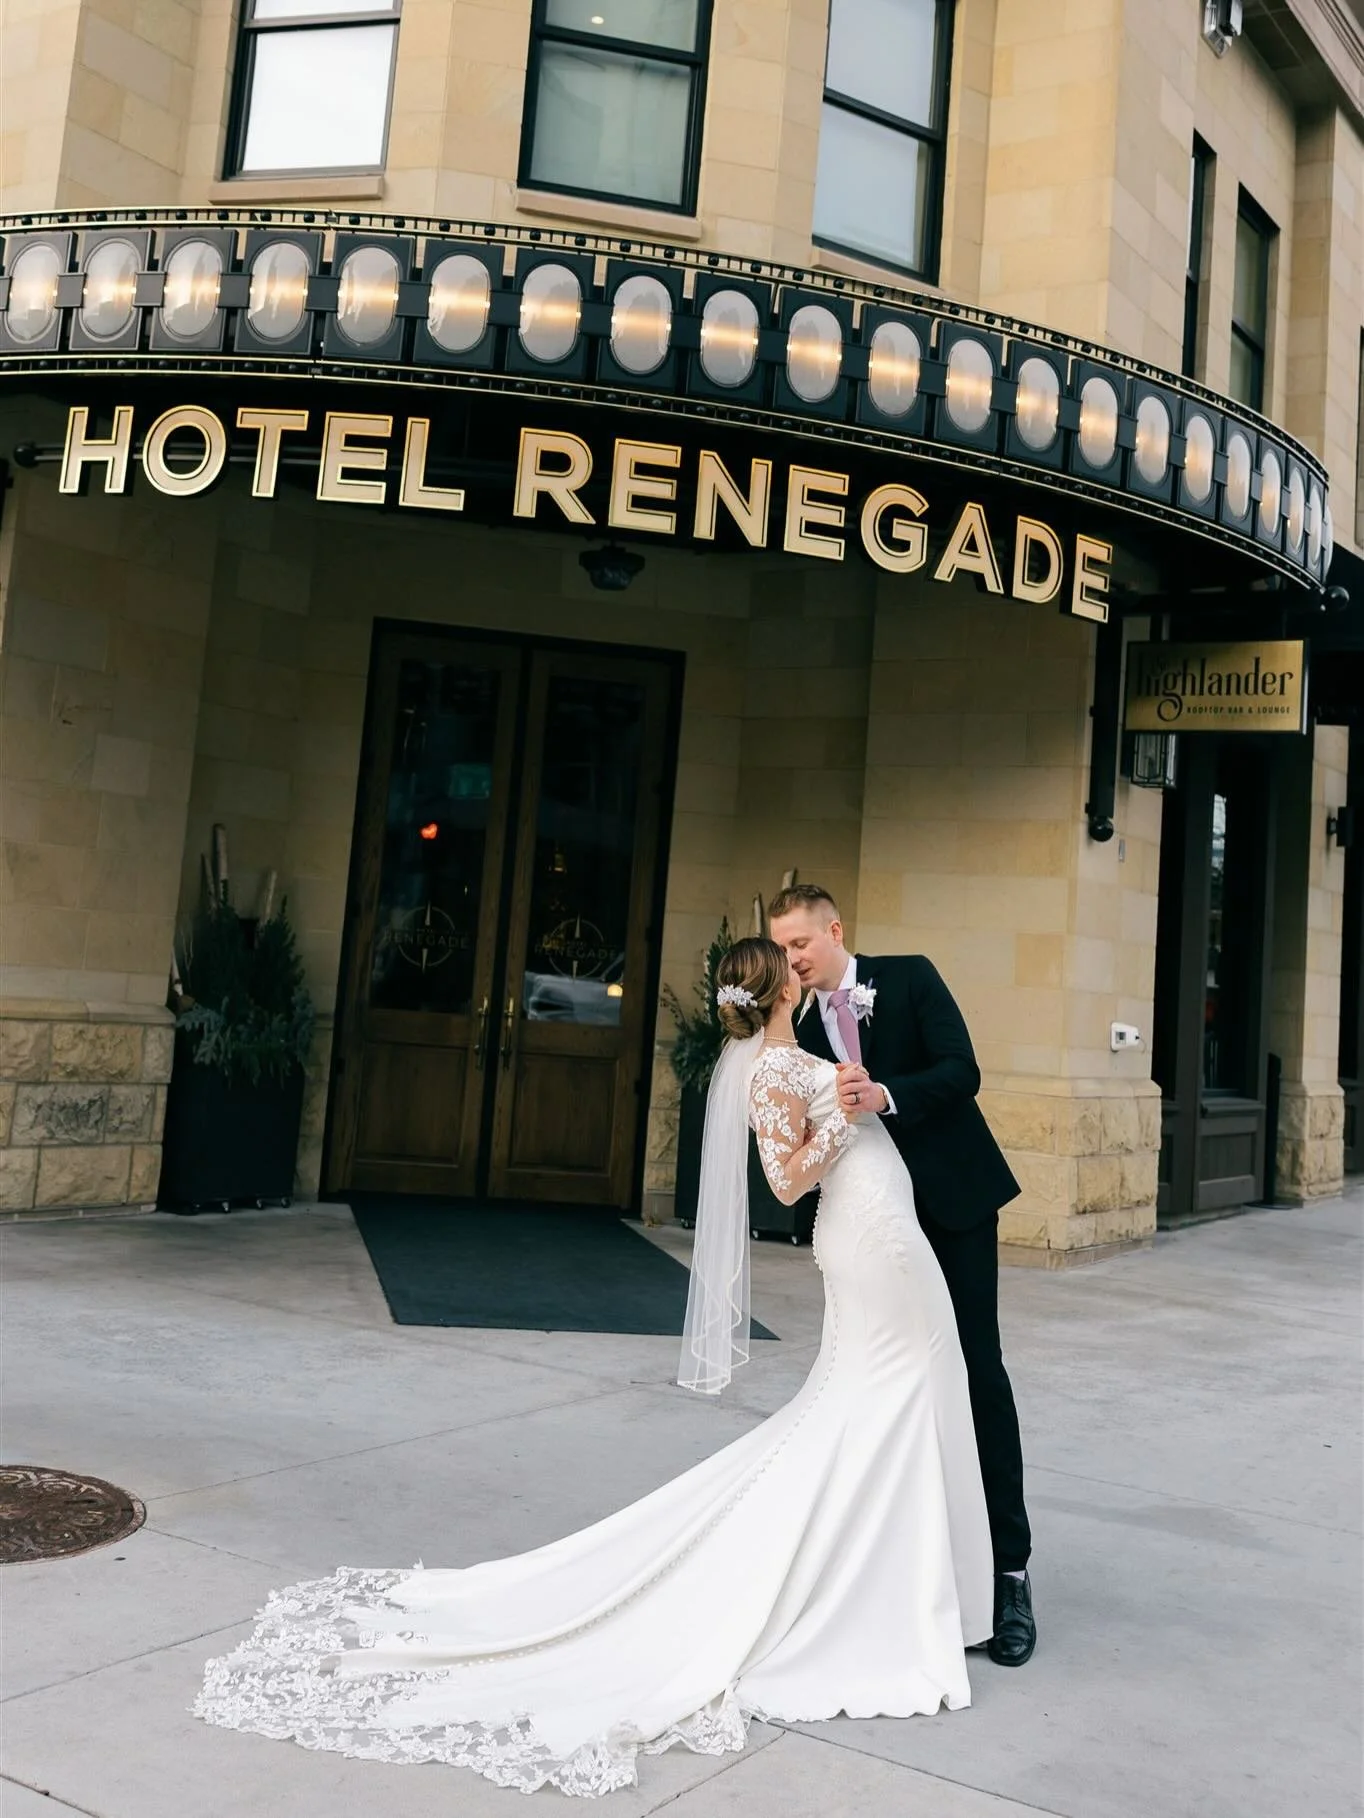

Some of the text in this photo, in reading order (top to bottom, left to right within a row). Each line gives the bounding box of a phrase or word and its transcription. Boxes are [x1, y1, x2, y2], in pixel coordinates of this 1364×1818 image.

[58, 404, 1113, 623] HOTEL RENEGADE
[1136, 653, 1294, 722] highlander
[1187, 706, 1290, 714] ROOFTOP BAR & LOUNGE
